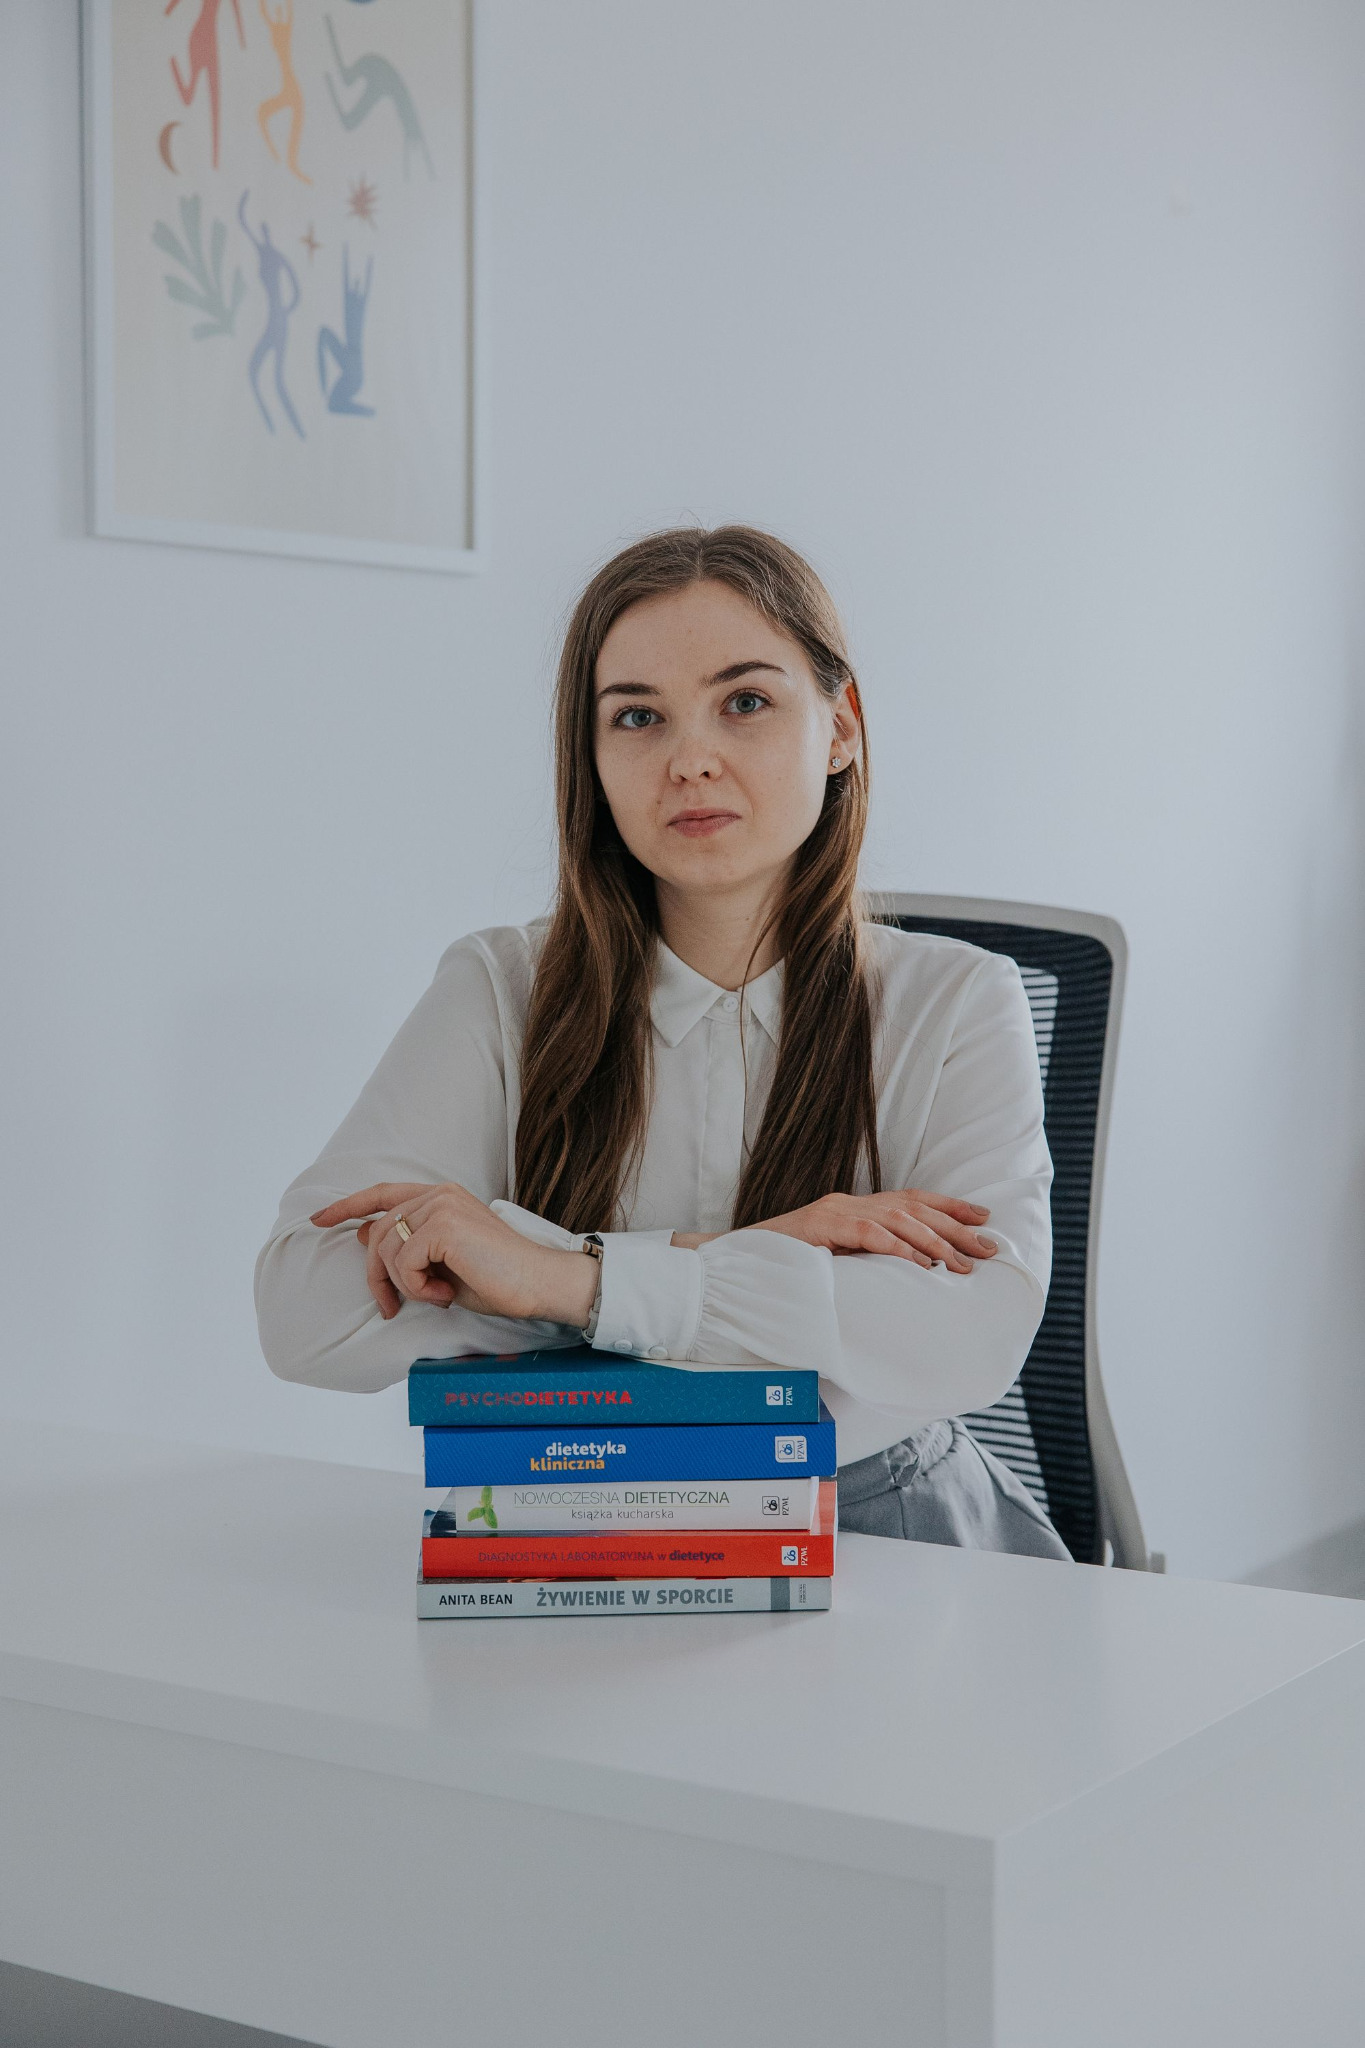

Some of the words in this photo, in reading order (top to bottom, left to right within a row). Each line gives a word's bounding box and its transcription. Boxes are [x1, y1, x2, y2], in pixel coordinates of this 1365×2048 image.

[445, 1390, 632, 1406] PSYCHODIETETYKA
[546, 1441, 626, 1459] dietetyka
[530, 1457, 605, 1472] kliniczna
[514, 1492, 620, 1505] NOWOCZESNA
[624, 1491, 730, 1504] DIETETYCZNA
[571, 1507, 613, 1521] książka
[617, 1507, 674, 1519] kucharska
[560, 1551, 654, 1562] LABORATORYJNA
[657, 1553, 667, 1561] w
[669, 1550, 725, 1563] dietetyce
[439, 1594, 476, 1606] ANITA
[480, 1593, 513, 1605] BEAN
[536, 1587, 625, 1606] ŻYWIENIE
[631, 1589, 652, 1606] W
[656, 1588, 733, 1605] SPORCIE
